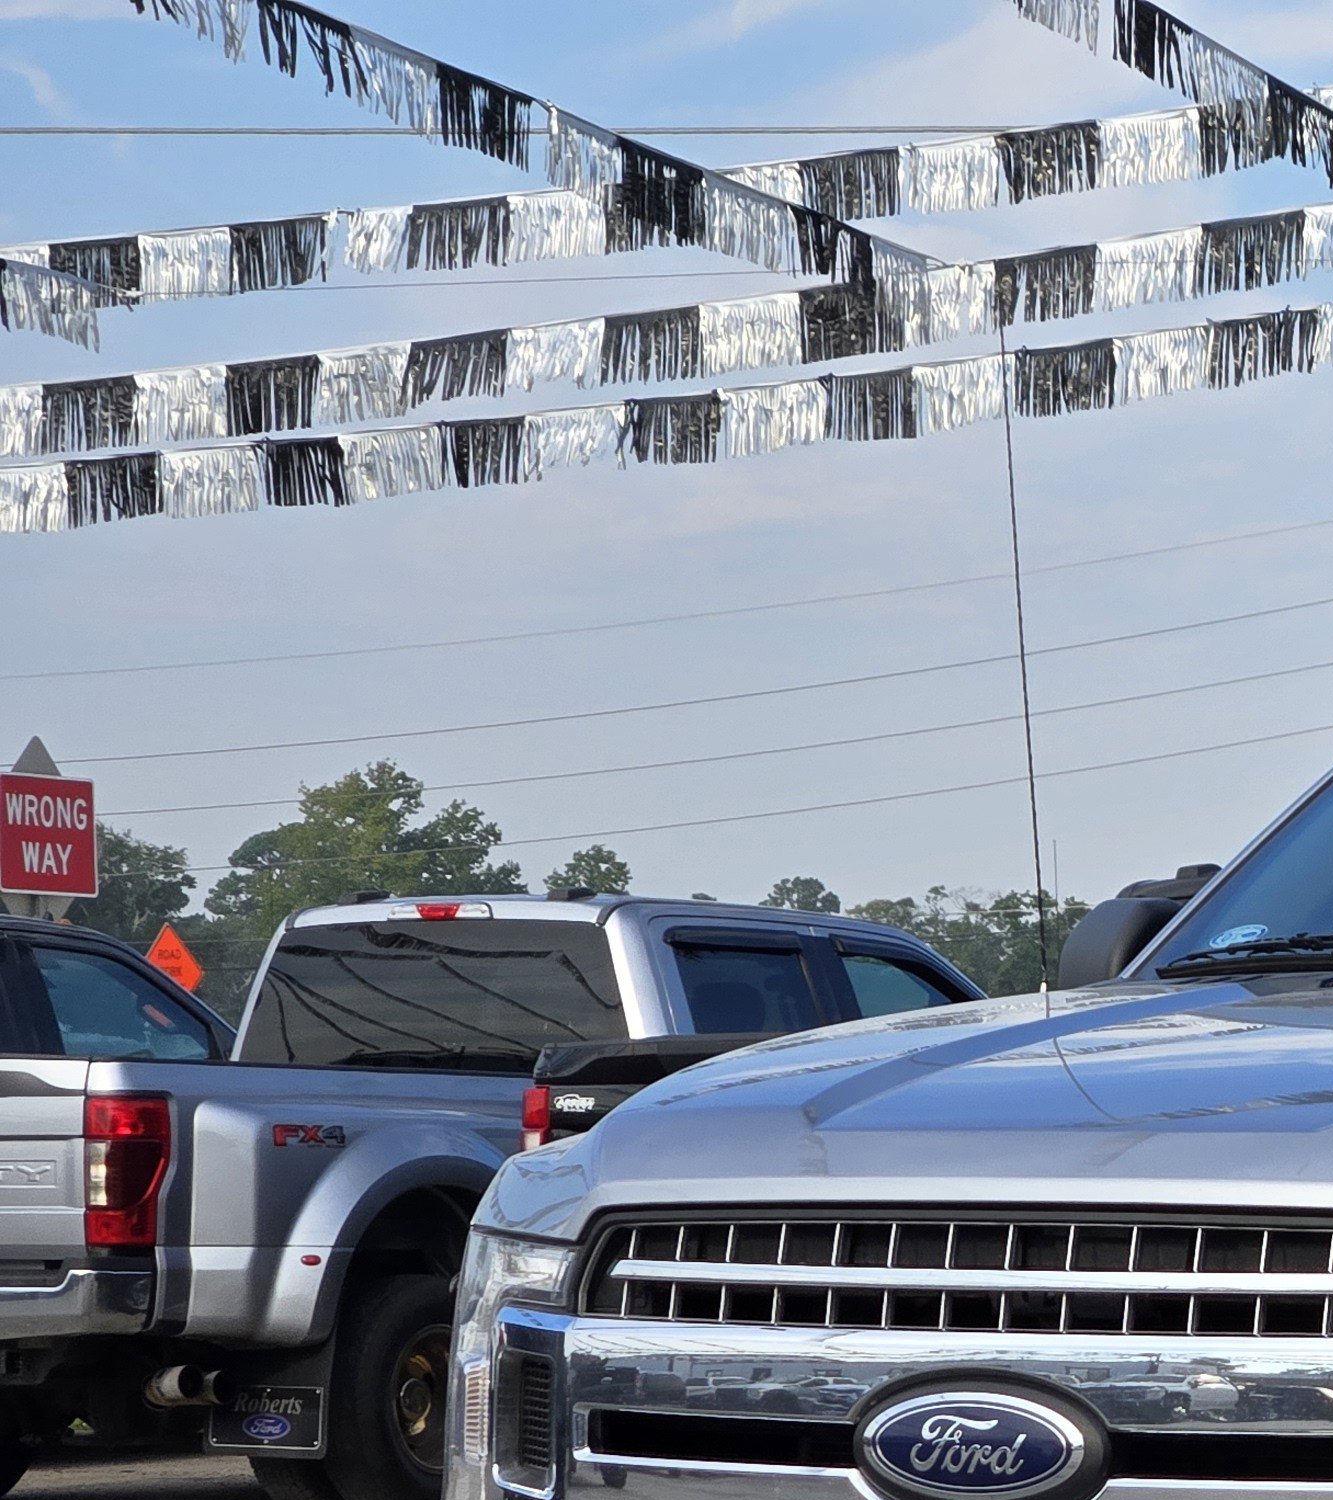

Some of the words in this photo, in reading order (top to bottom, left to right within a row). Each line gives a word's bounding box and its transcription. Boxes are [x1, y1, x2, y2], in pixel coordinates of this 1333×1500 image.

[6, 793, 87, 830] WRONG
[22, 841, 72, 875] WAY
[272, 1124, 346, 1146] FX4
[232, 1392, 303, 1415] Roberts
[249, 1418, 283, 1433] Ford
[909, 1414, 1027, 1475] Ford
